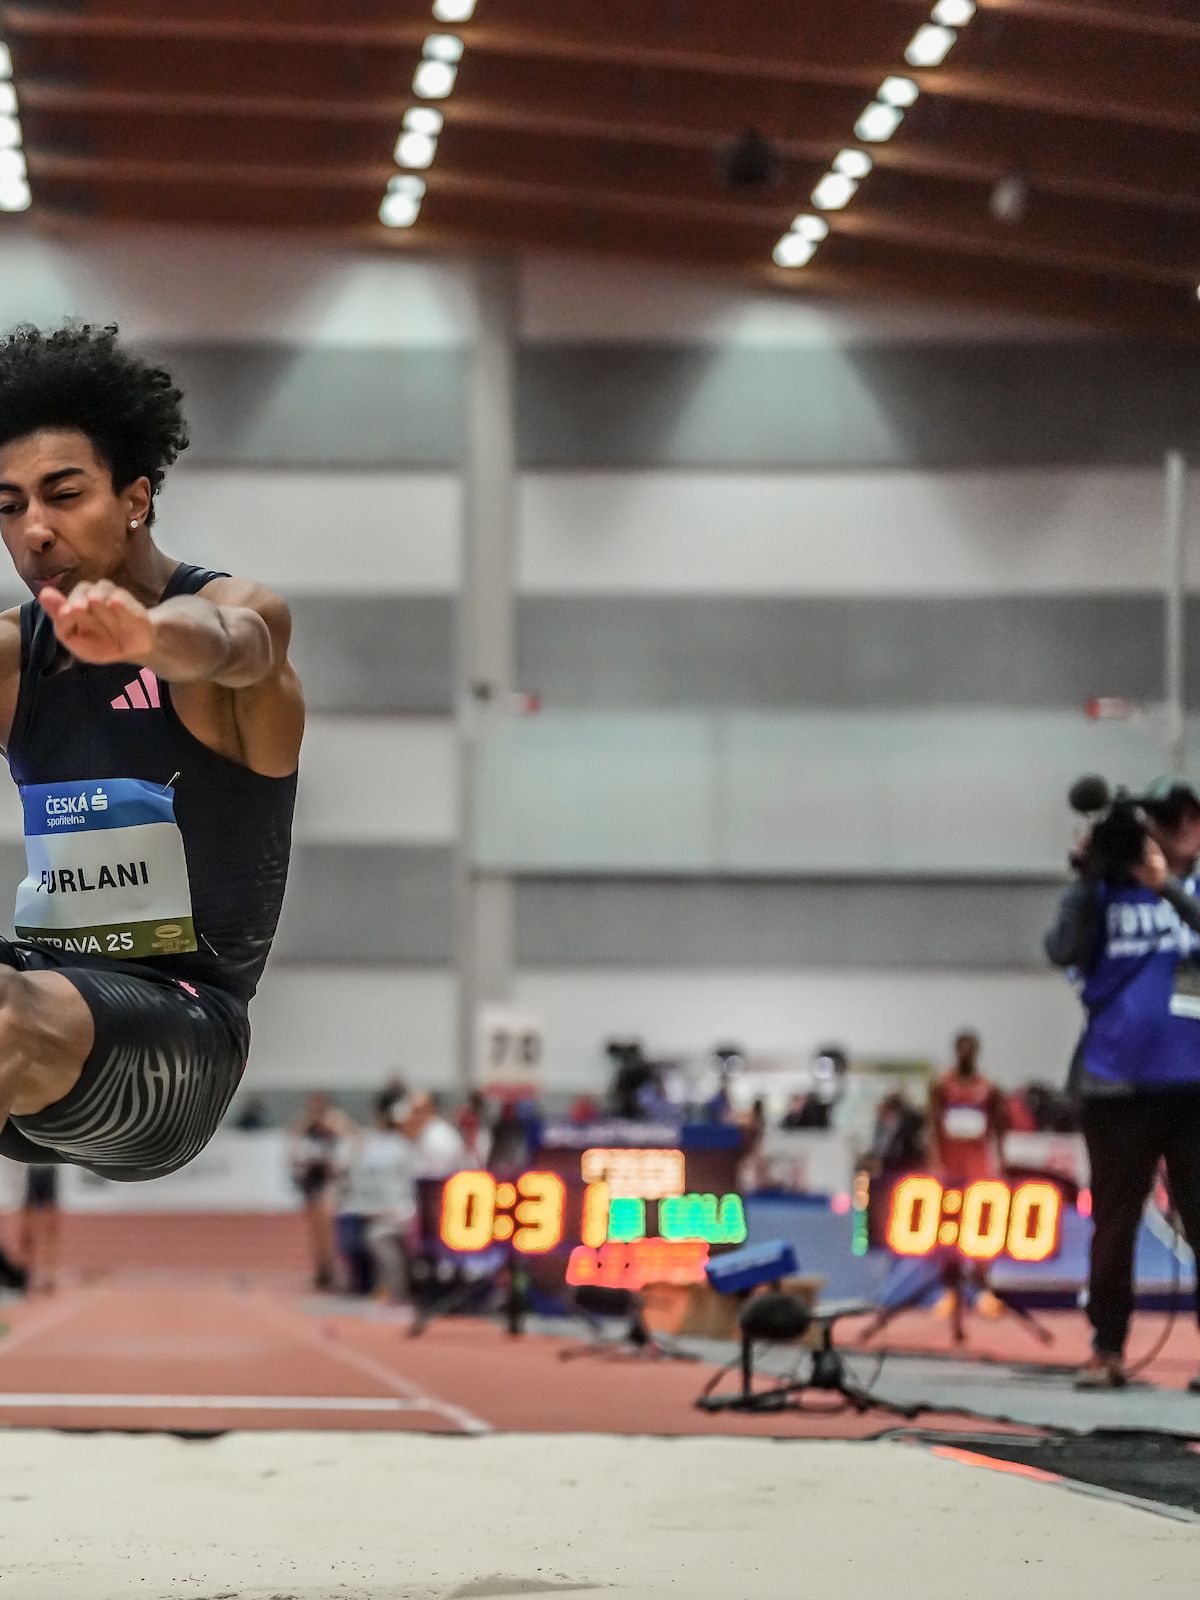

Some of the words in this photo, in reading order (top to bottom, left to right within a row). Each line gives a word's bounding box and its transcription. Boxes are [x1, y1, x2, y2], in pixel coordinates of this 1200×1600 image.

[45, 792, 89, 815] ČESKÁ
[46, 814, 86, 828] spořitelna
[105, 932, 135, 952] 25
[887, 1174, 1062, 1262] 0:00
